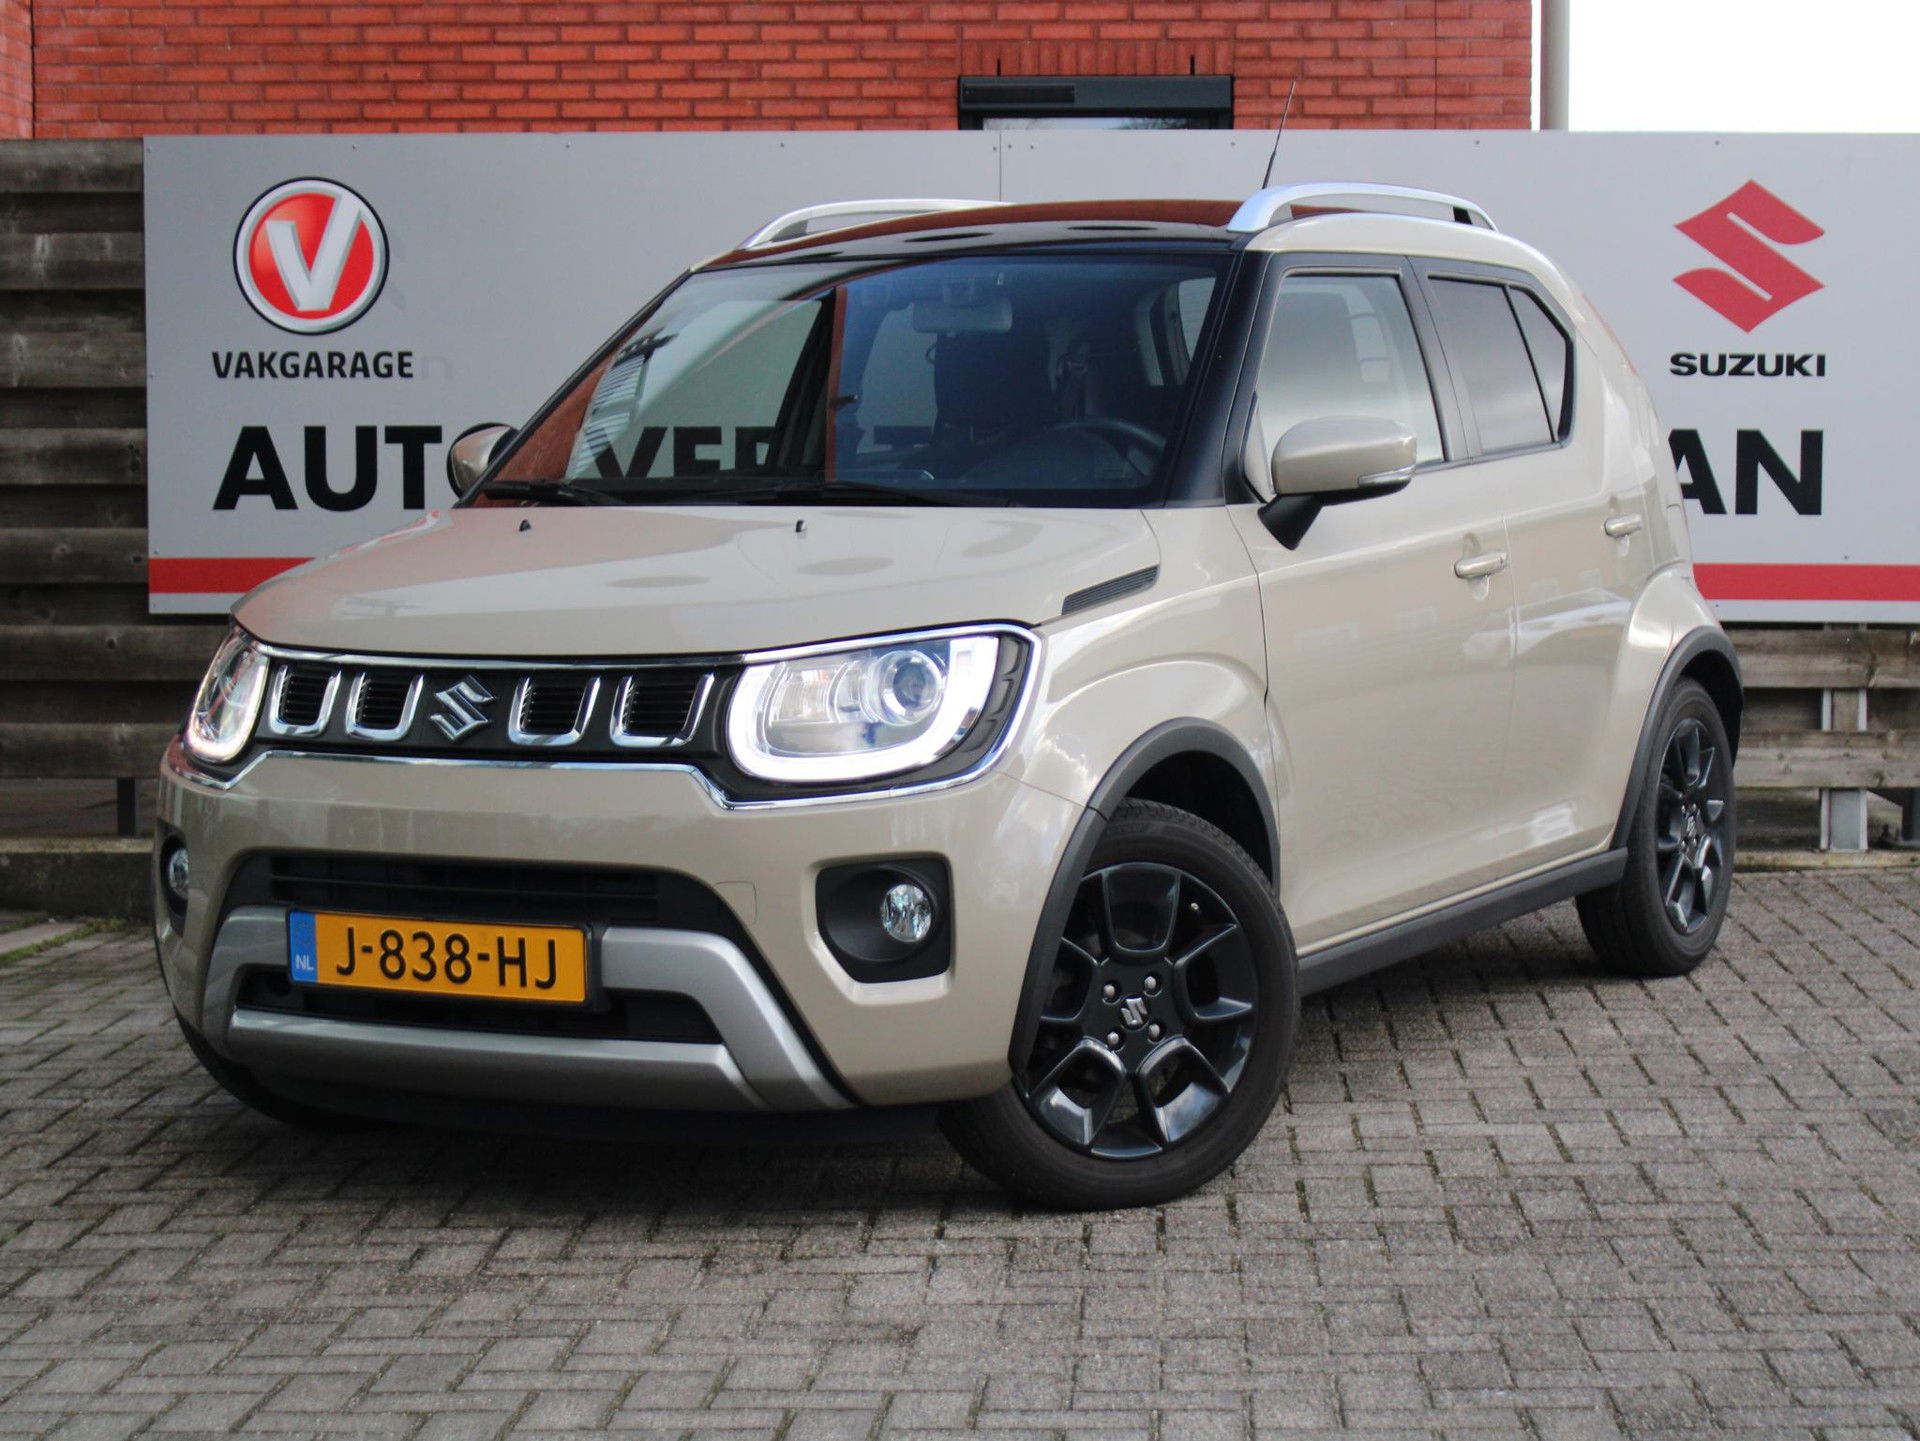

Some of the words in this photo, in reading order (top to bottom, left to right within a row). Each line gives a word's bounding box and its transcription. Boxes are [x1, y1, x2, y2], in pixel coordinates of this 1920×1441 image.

[212, 350, 414, 379] VAKGARAGE
[1670, 352, 1827, 377] SUZUKI
[212, 422, 505, 512] AUT
[295, 953, 315, 971] NL
[336, 926, 558, 990] J-838-HJ
